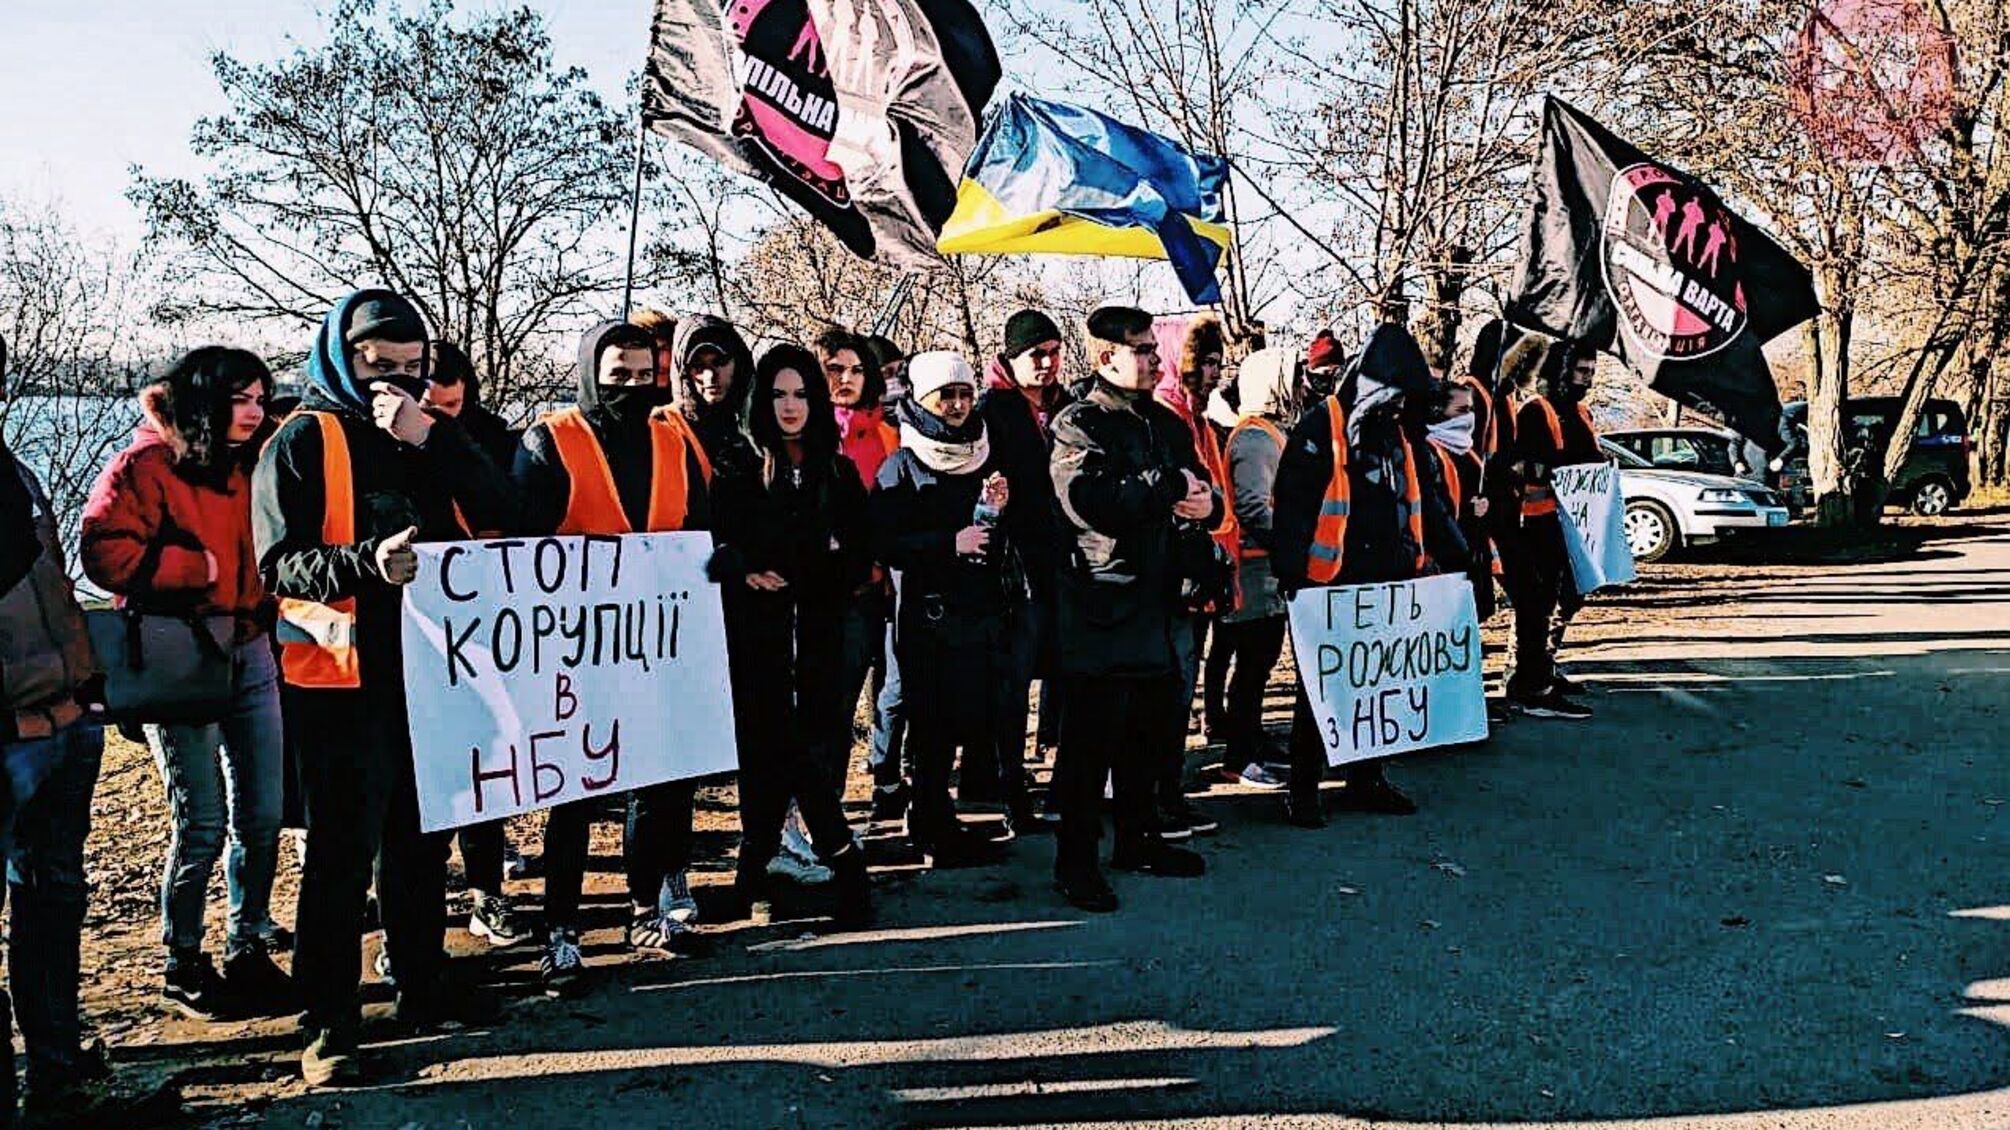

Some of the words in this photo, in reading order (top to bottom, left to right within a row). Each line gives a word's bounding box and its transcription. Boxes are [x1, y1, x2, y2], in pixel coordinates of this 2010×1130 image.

[735, 50, 836, 133] ПІЛЬНА
[1682, 278, 1737, 333] ВАРТА
[440, 535, 623, 602] СТОП
[444, 590, 689, 687] КОРУПЦІЇ
[1327, 583, 1422, 630] ГЕТЬ
[1318, 625, 1471, 702] РОЖКОВУ
[1352, 686, 1428, 751] НБУ
[471, 718, 620, 813] НБУ
